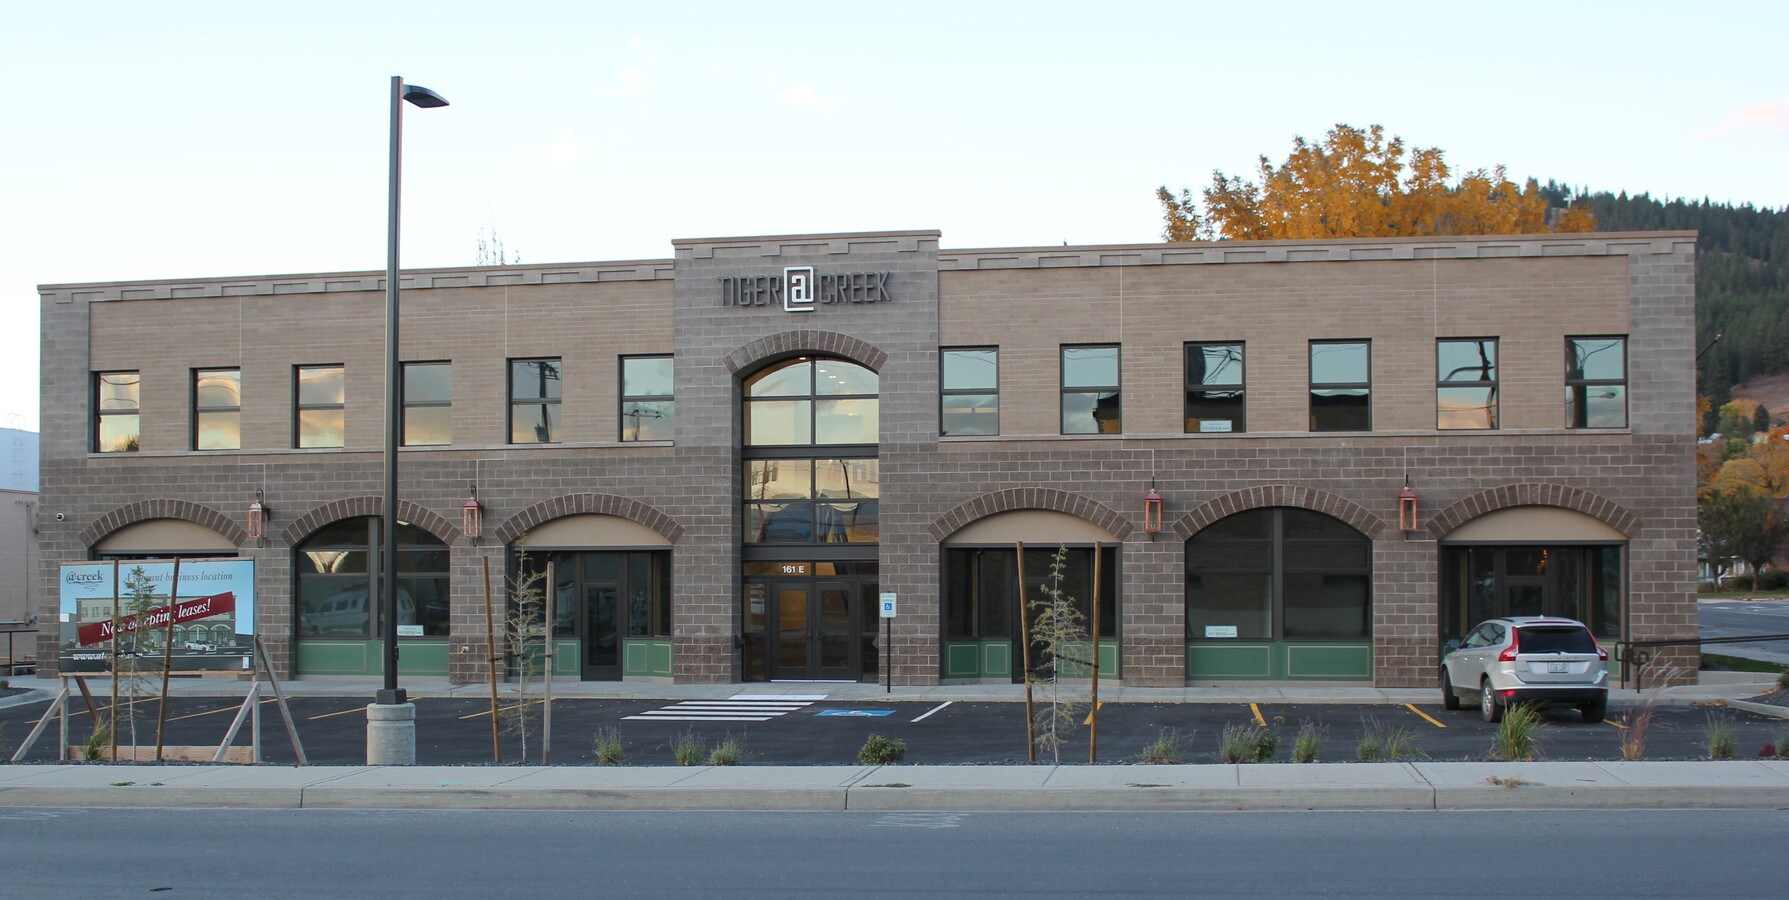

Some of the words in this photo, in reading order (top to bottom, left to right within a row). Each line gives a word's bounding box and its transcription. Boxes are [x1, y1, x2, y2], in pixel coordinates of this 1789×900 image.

[718, 275, 780, 306] TIGER
[818, 271, 891, 303] CREEK
[66, 569, 104, 583] @creek
[201, 571, 233, 581] location
[782, 565, 796, 573] 161
[798, 565, 804, 573] E
[178, 598, 211, 618] leases!
